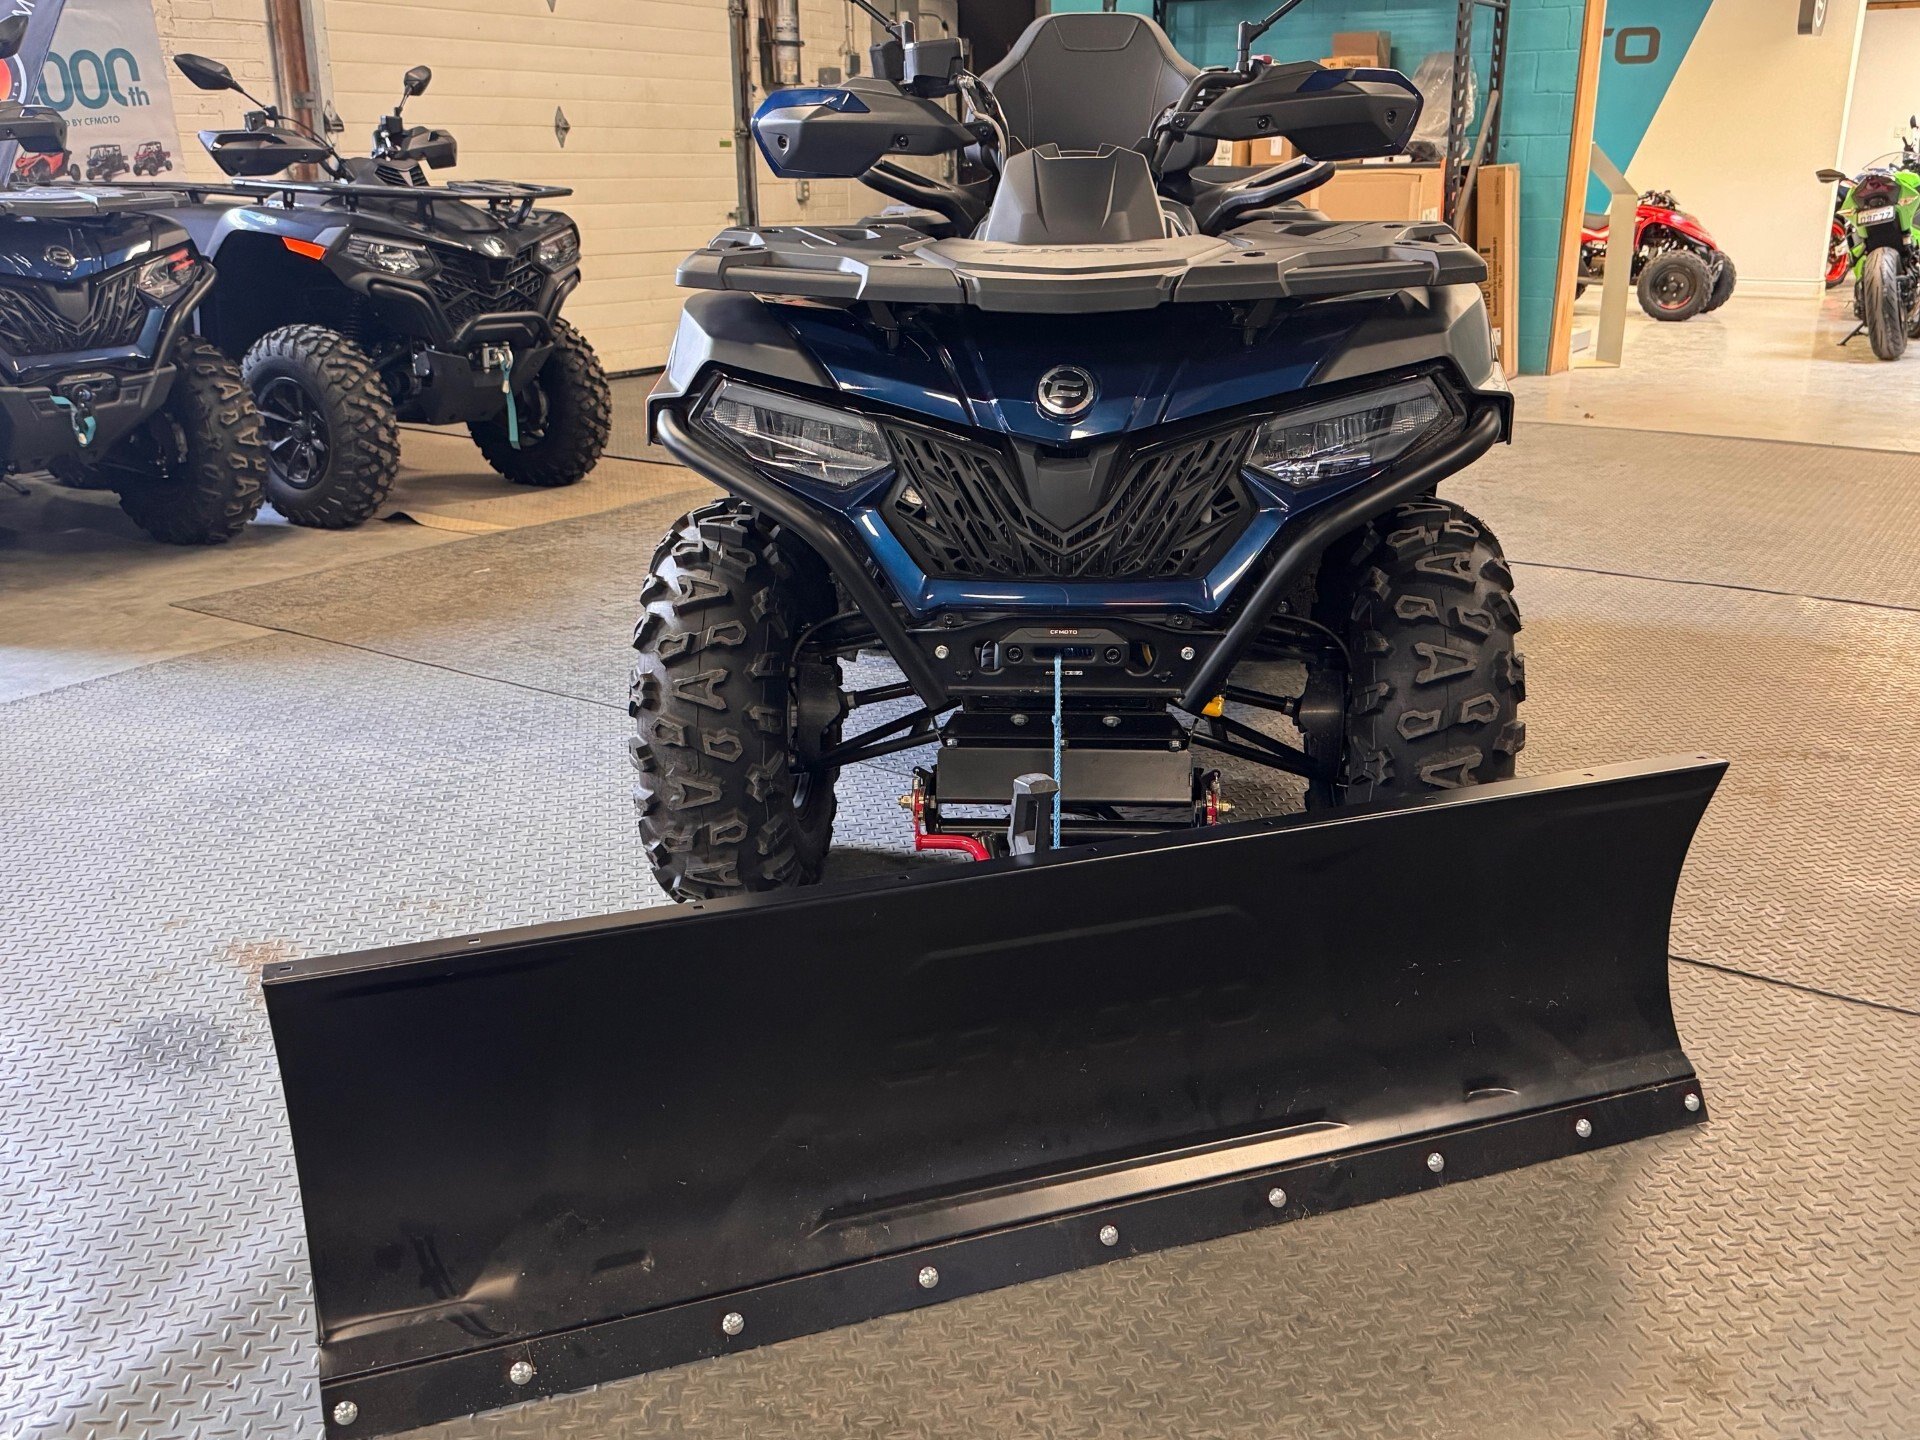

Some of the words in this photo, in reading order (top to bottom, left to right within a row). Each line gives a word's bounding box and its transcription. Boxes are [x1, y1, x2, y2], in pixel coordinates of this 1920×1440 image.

[1603, 27, 1661, 65] O
[35, 48, 150, 112] 000th
[72, 118, 82, 127] BY
[84, 115, 120, 126] CFMOTO
